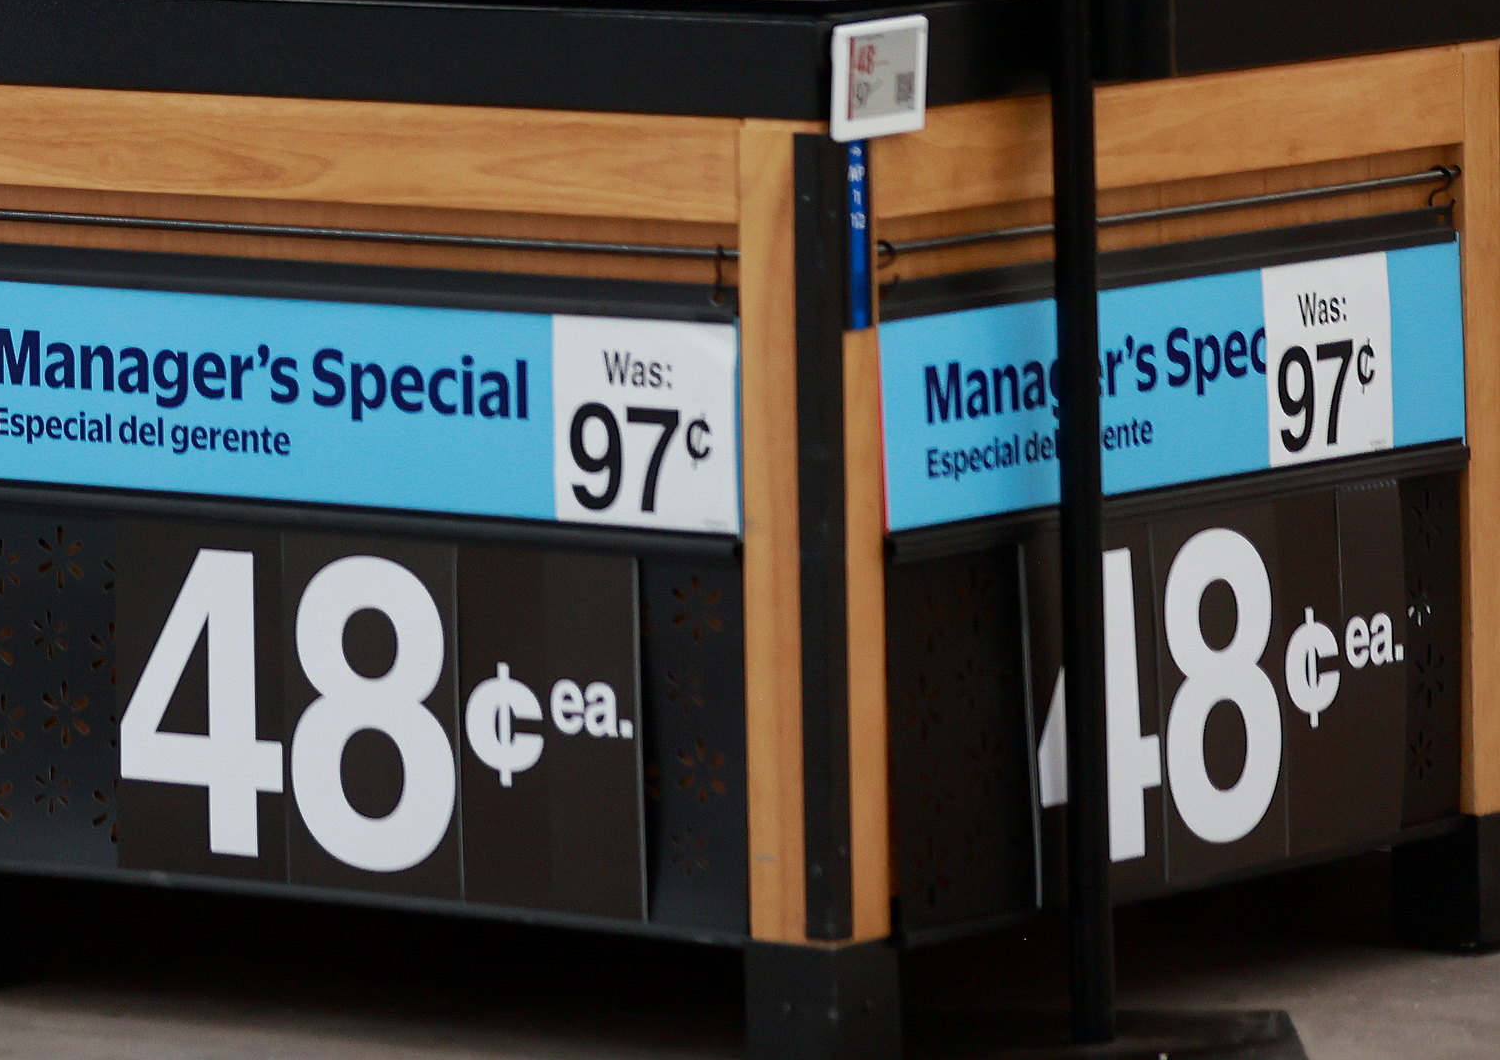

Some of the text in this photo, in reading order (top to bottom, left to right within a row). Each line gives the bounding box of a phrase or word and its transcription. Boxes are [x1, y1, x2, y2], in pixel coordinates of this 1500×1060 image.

[1297, 291, 1348, 329] Was:
[311, 347, 529, 422] Special
[603, 350, 674, 390] Was:
[924, 326, 1267, 425] Manar's Spec
[118, 415, 165, 447] del
[170, 424, 292, 456] gerente
[926, 433, 1022, 482] Especial
[1102, 417, 1154, 451] ente
[1345, 612, 1405, 669] ea.
[550, 678, 634, 740] ea.
